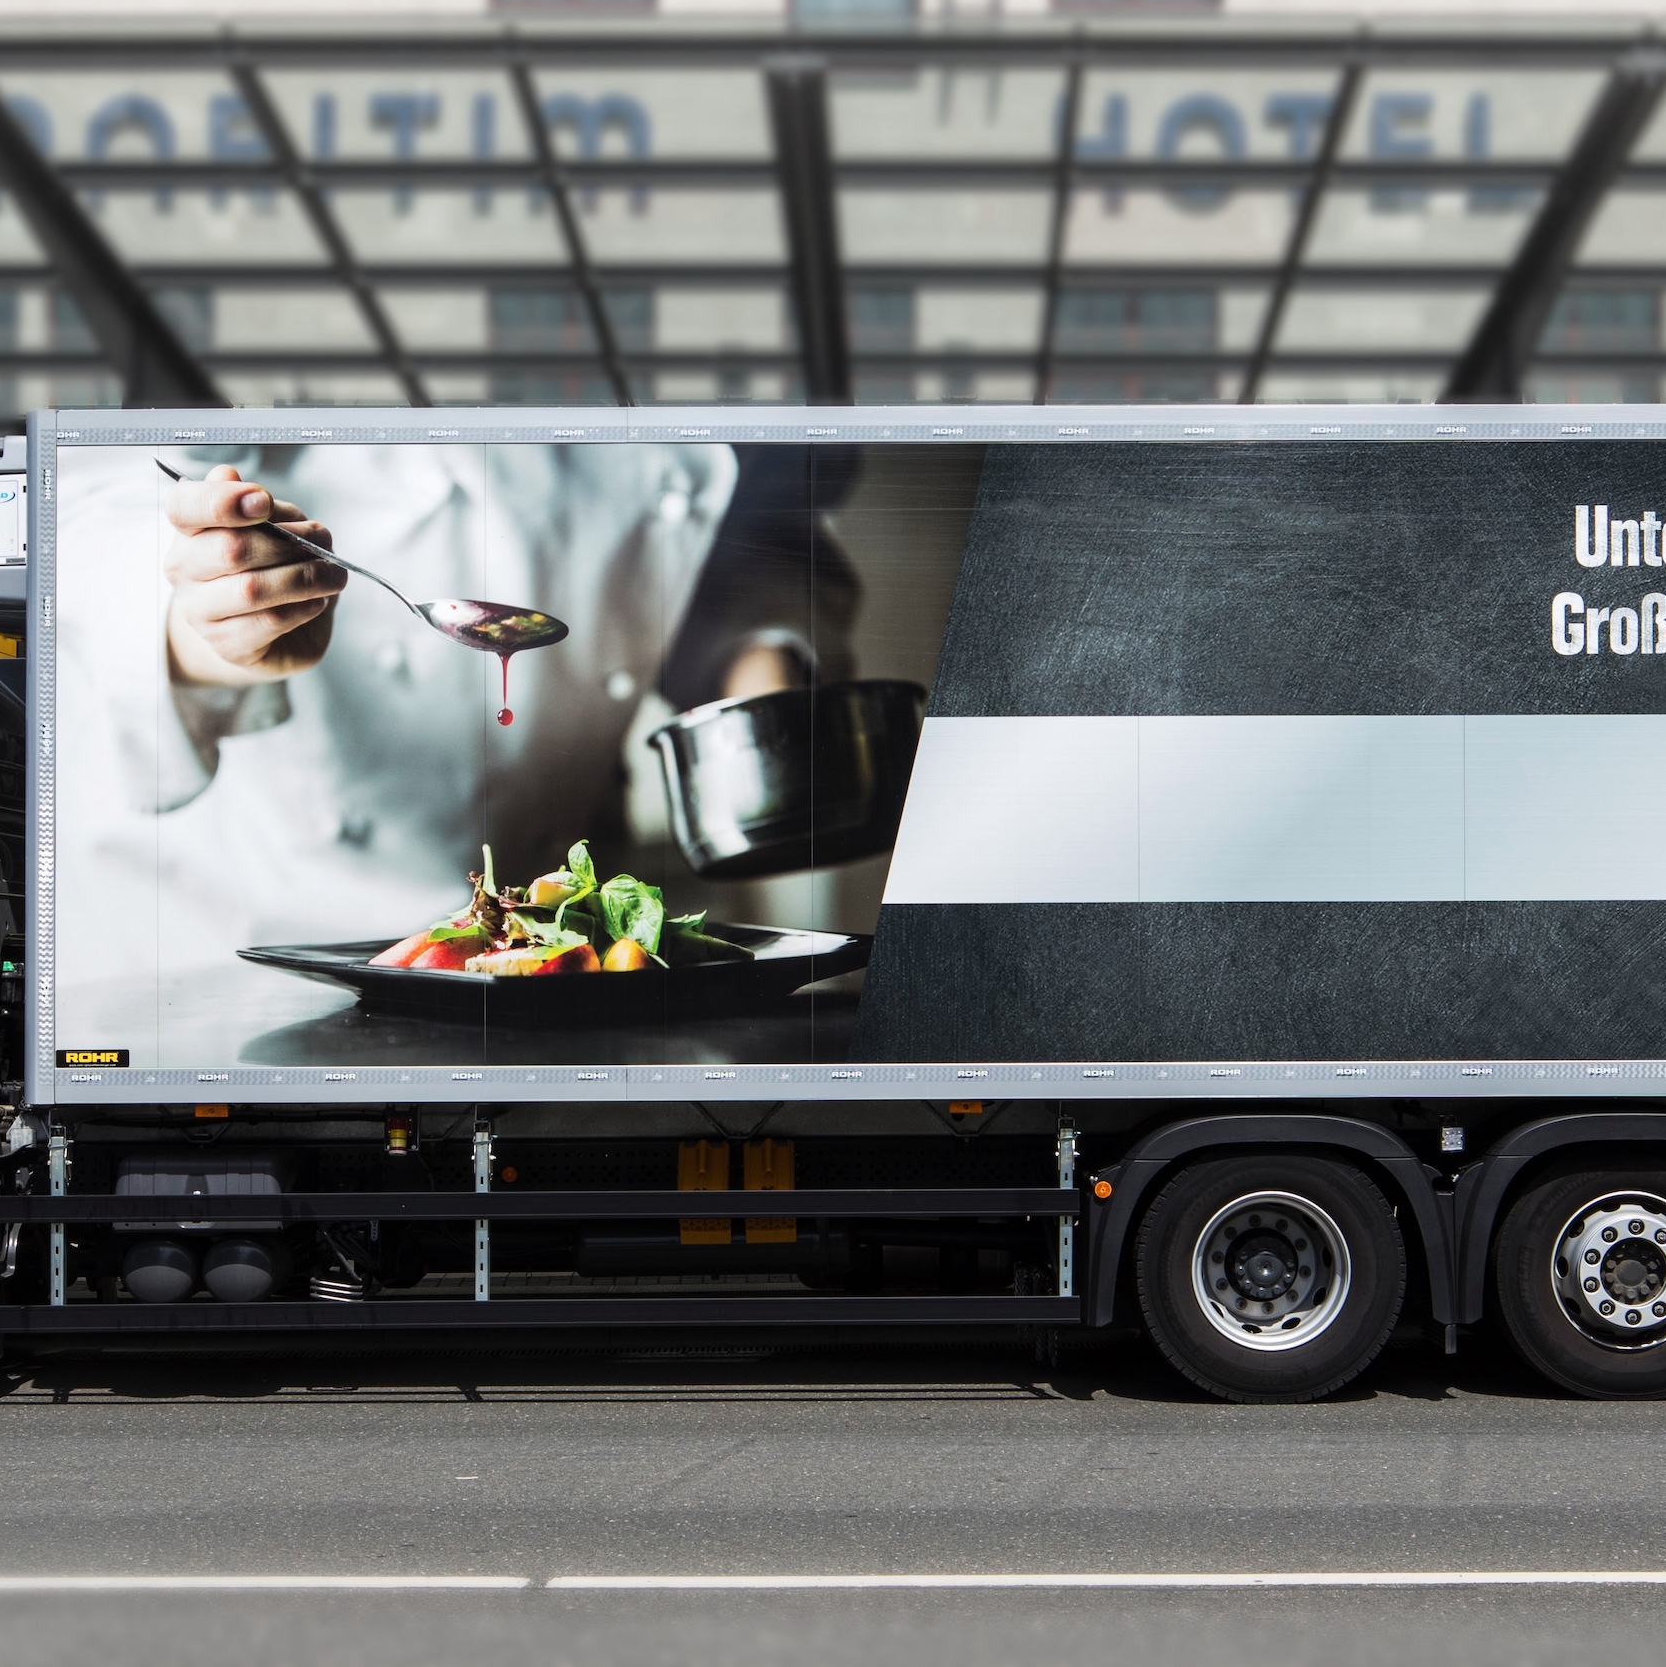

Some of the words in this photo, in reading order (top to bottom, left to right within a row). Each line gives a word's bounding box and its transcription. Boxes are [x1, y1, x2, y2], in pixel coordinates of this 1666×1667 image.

[300, 430, 332, 438] ROHR
[427, 429, 459, 437] ROHR
[553, 429, 585, 437] ROHR
[679, 429, 711, 437] ROHR
[806, 428, 838, 436] ROHR
[931, 428, 963, 436] ROHR
[1057, 427, 1089, 435] ROHR
[1183, 427, 1215, 435] ROHR
[1309, 426, 1341, 434] ROHR
[1435, 426, 1467, 434] ROHR
[1560, 426, 1592, 434] ROHR
[57, 431, 81, 439] OHR
[174, 431, 206, 439] ROHR
[66, 1052, 119, 1063] ROHR
[704, 1071, 737, 1079] ROHR
[830, 1071, 863, 1079] ROHR
[956, 1070, 989, 1078] ROHR
[1082, 1069, 1115, 1077] ROHR
[1209, 1068, 1242, 1076] ROHR
[1335, 1068, 1368, 1076] ROHR
[1461, 1067, 1494, 1075] ROHR
[70, 1074, 103, 1082] ROHR
[197, 1073, 230, 1081] ROHR
[324, 1073, 357, 1081] ROHR
[451, 1072, 484, 1080] ROHR
[576, 1072, 609, 1080] ROHR
